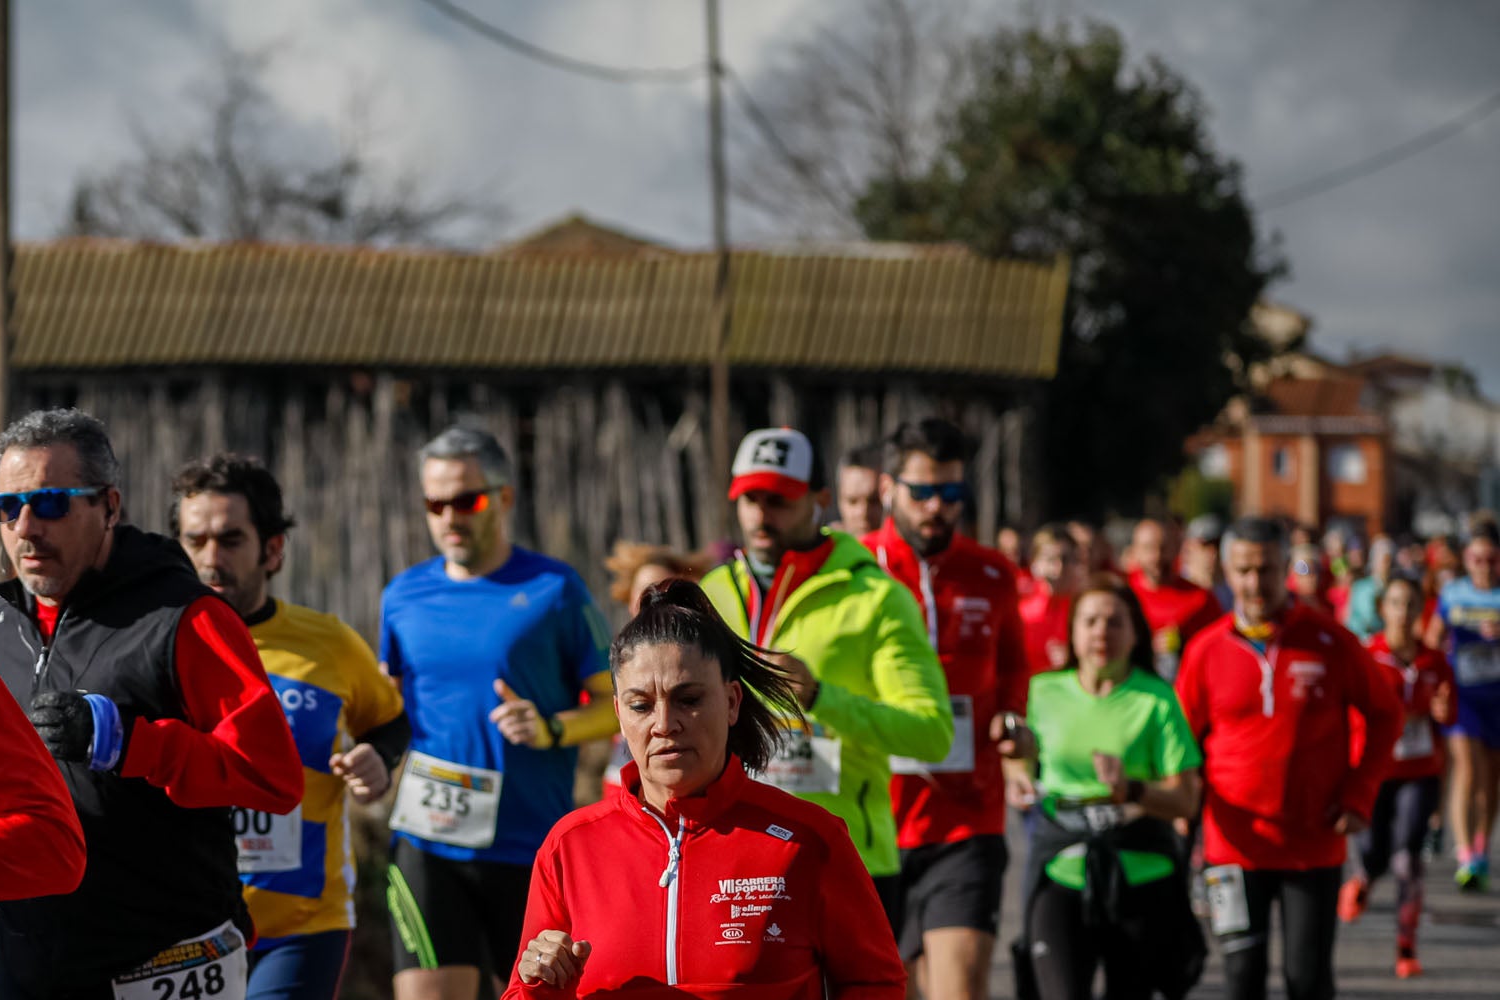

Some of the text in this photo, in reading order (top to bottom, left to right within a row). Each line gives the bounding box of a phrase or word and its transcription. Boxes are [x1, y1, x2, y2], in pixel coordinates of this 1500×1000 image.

[421, 782, 471, 816] 235
[735, 876, 786, 886] CARRERA
[718, 879, 735, 894] VII
[735, 884, 786, 893] POPULAR
[710, 893, 731, 903] Ruta
[733, 892, 743, 901] de
[742, 904, 772, 913] olimpo
